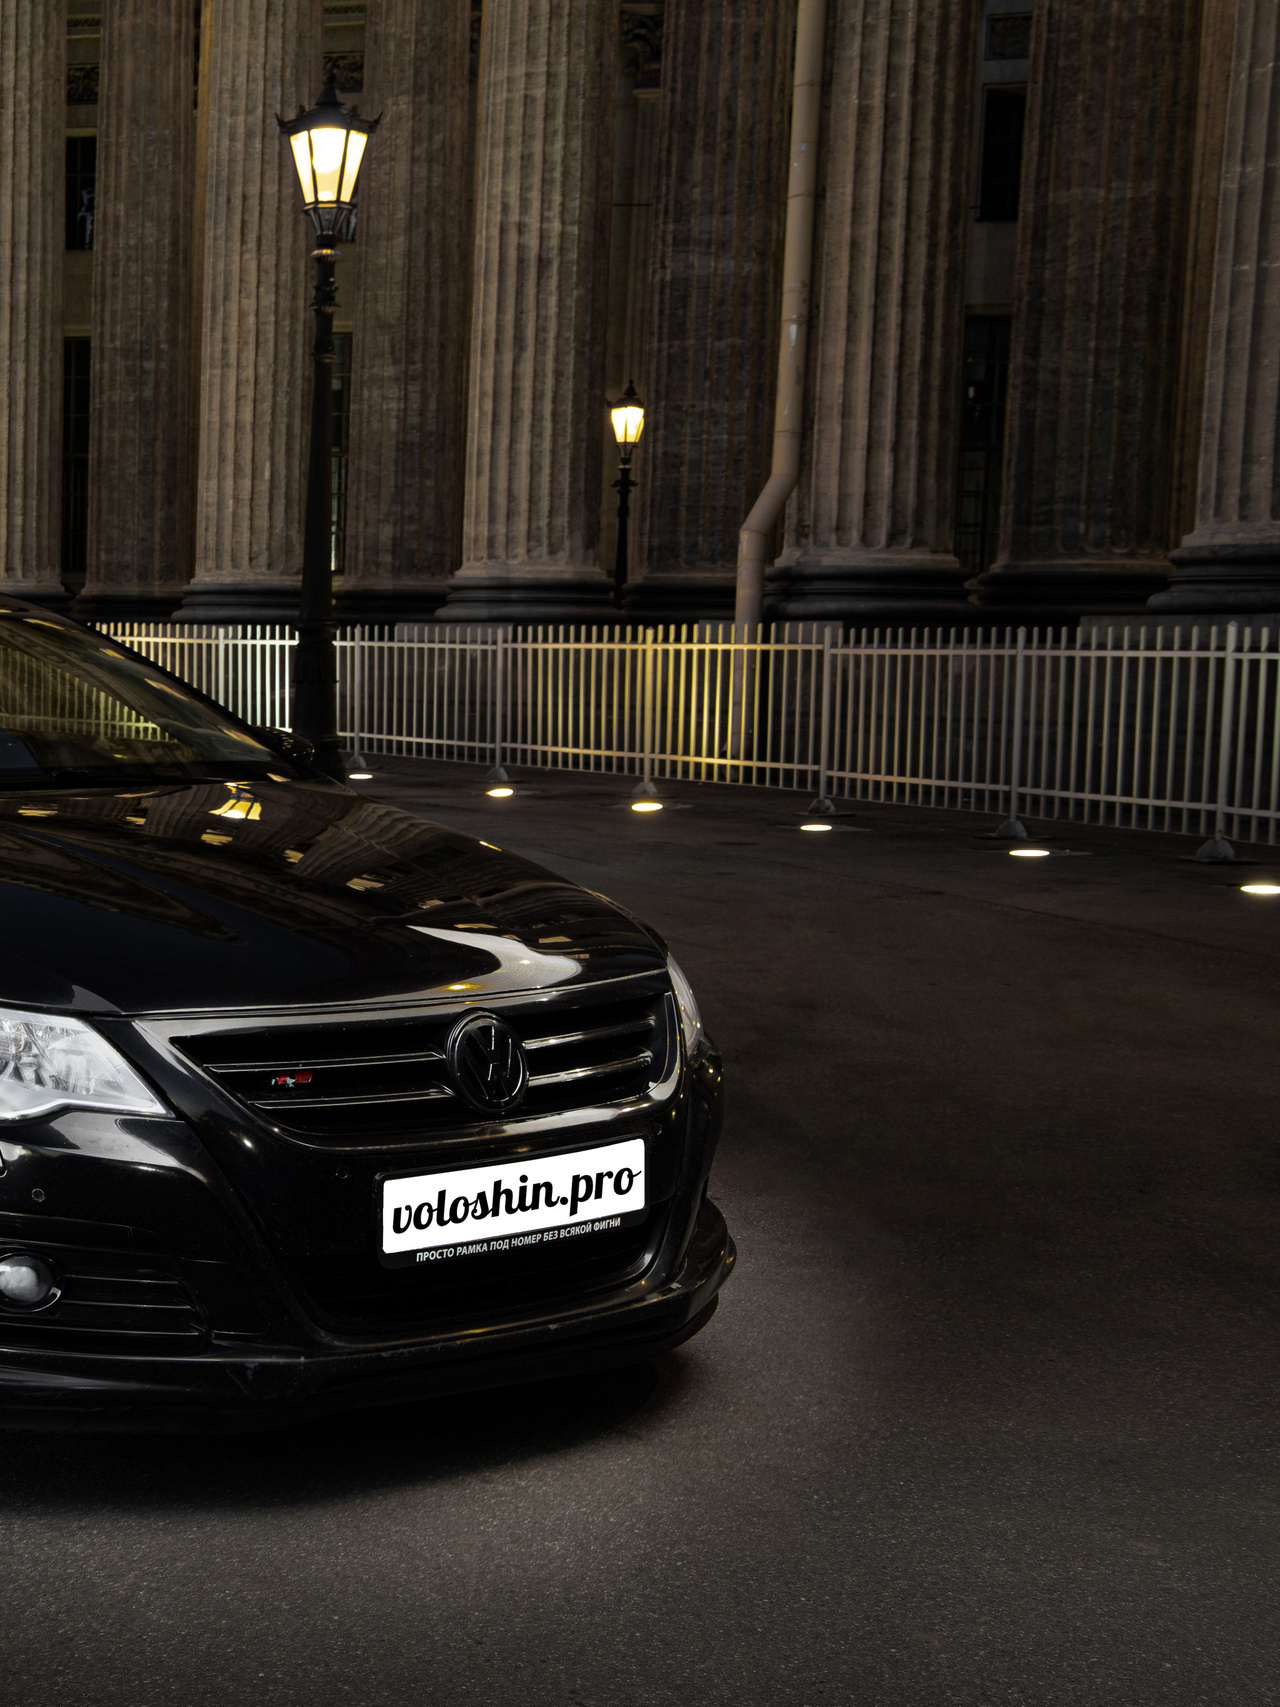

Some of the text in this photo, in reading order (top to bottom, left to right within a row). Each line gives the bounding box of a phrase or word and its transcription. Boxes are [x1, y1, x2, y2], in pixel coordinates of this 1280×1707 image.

[392, 1167, 641, 1234] voloshin.pro
[416, 1217, 621, 1262] ПРОСТО РАМКА ПОД НОМЕР БЕЗ ВСЯКОЙ ФИГНИ
